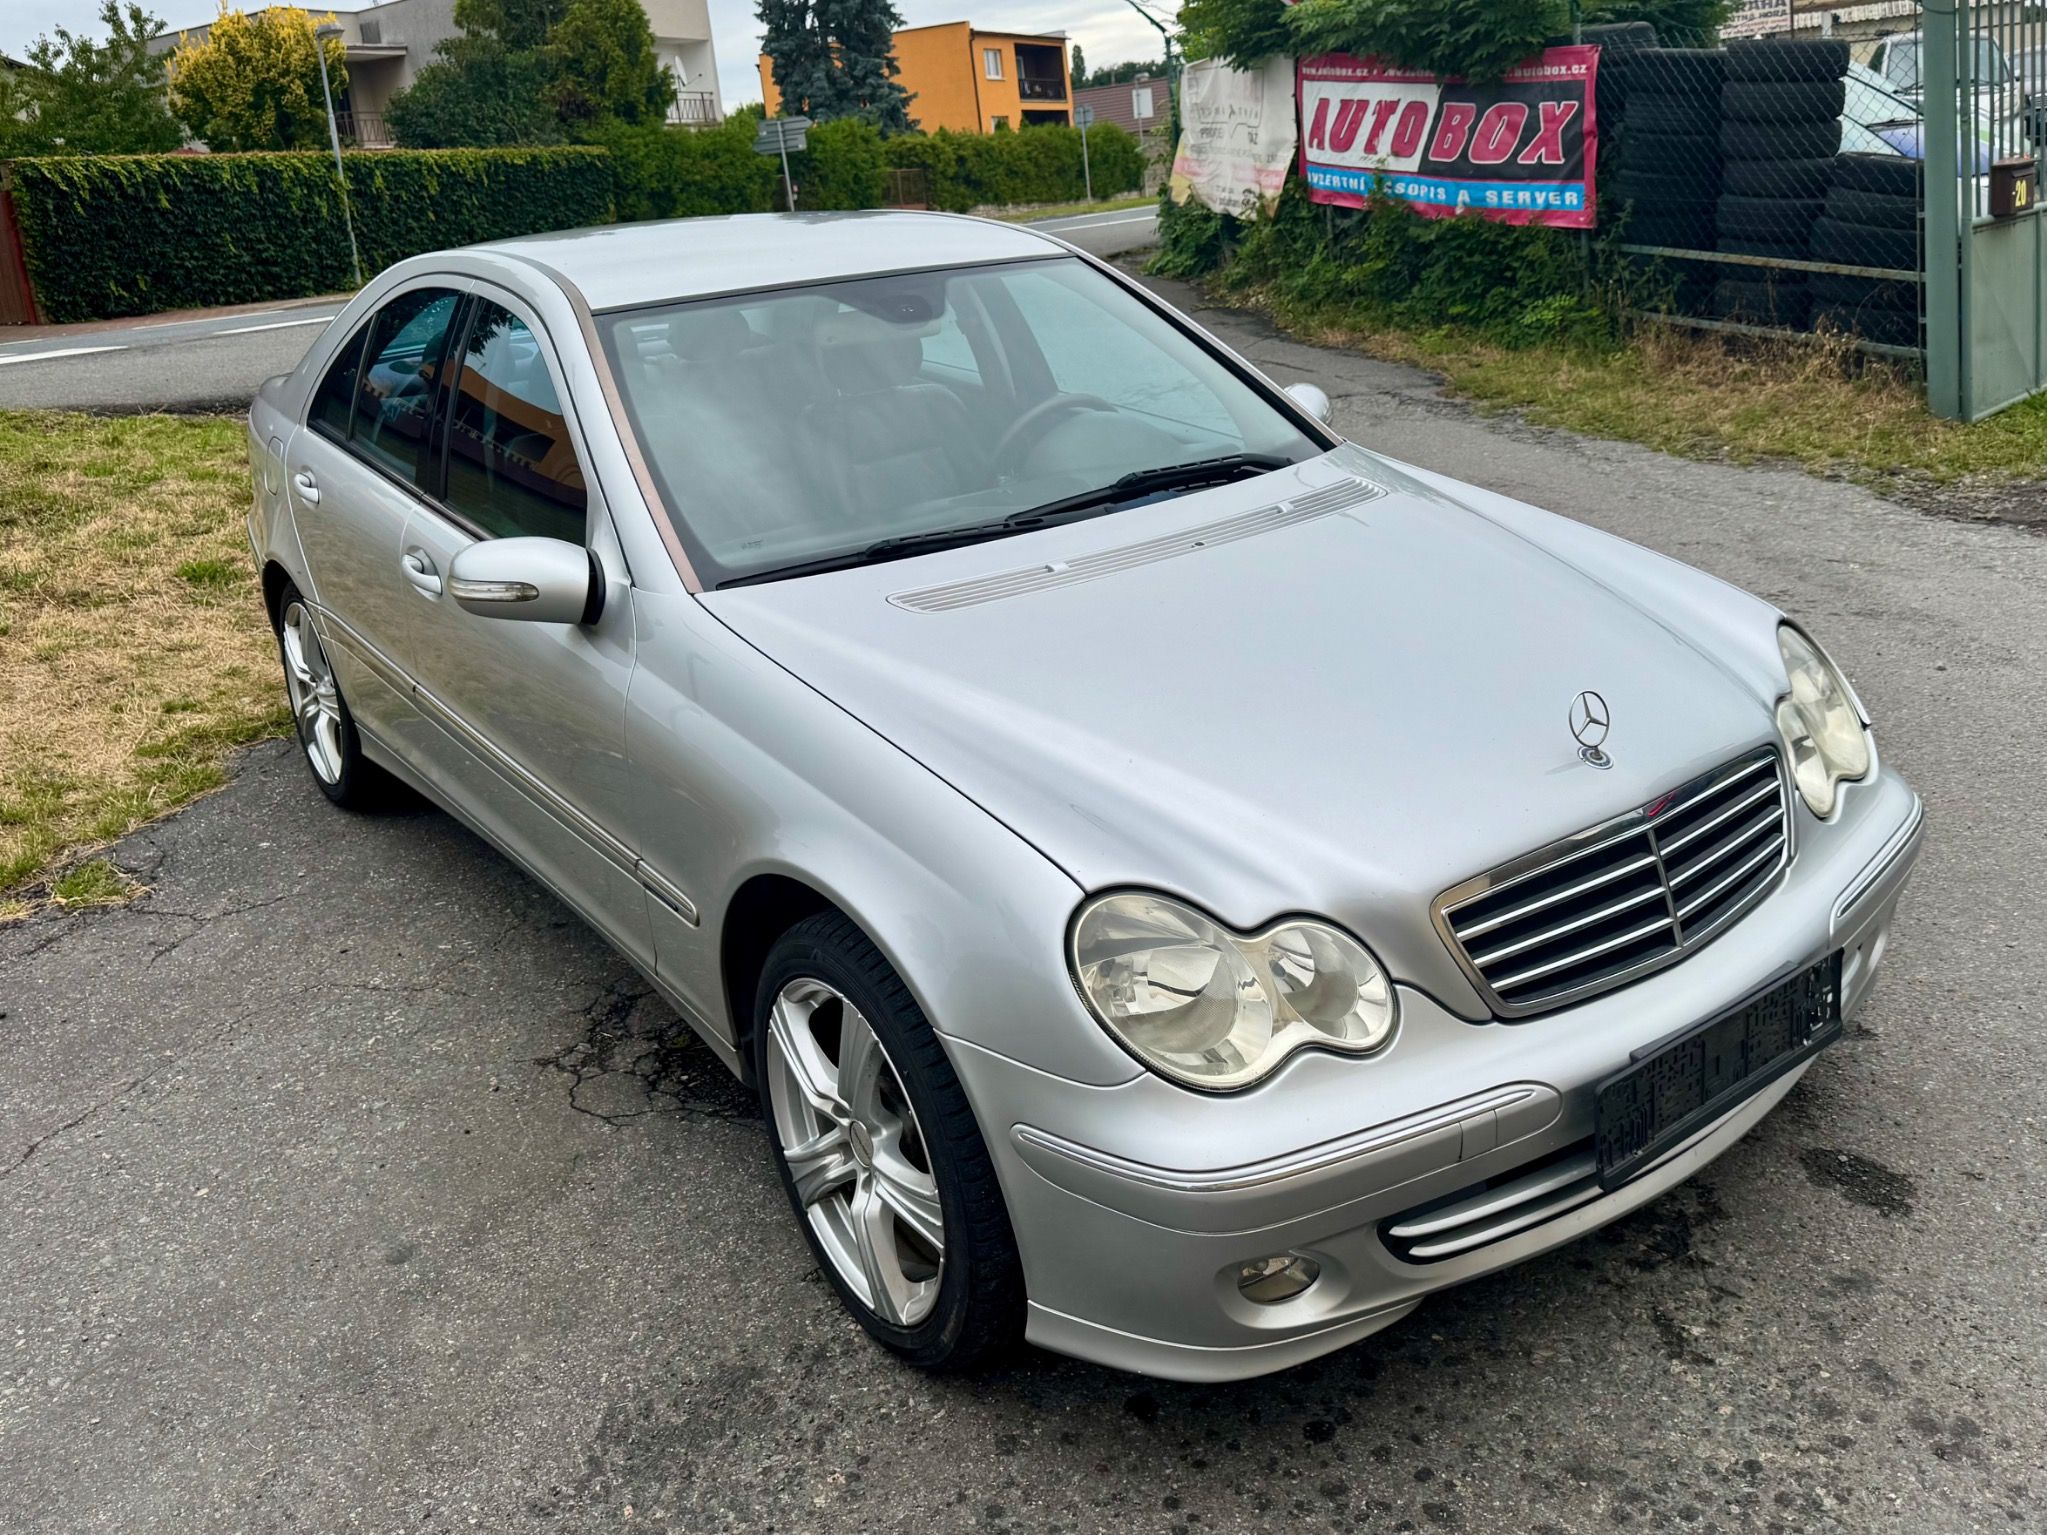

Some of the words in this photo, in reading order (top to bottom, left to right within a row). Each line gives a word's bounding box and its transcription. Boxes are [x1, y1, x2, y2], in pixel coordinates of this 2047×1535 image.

[1457, 189, 1470, 204] A
[1485, 190, 1579, 206] SERVER
[2015, 179, 2027, 207] 20
